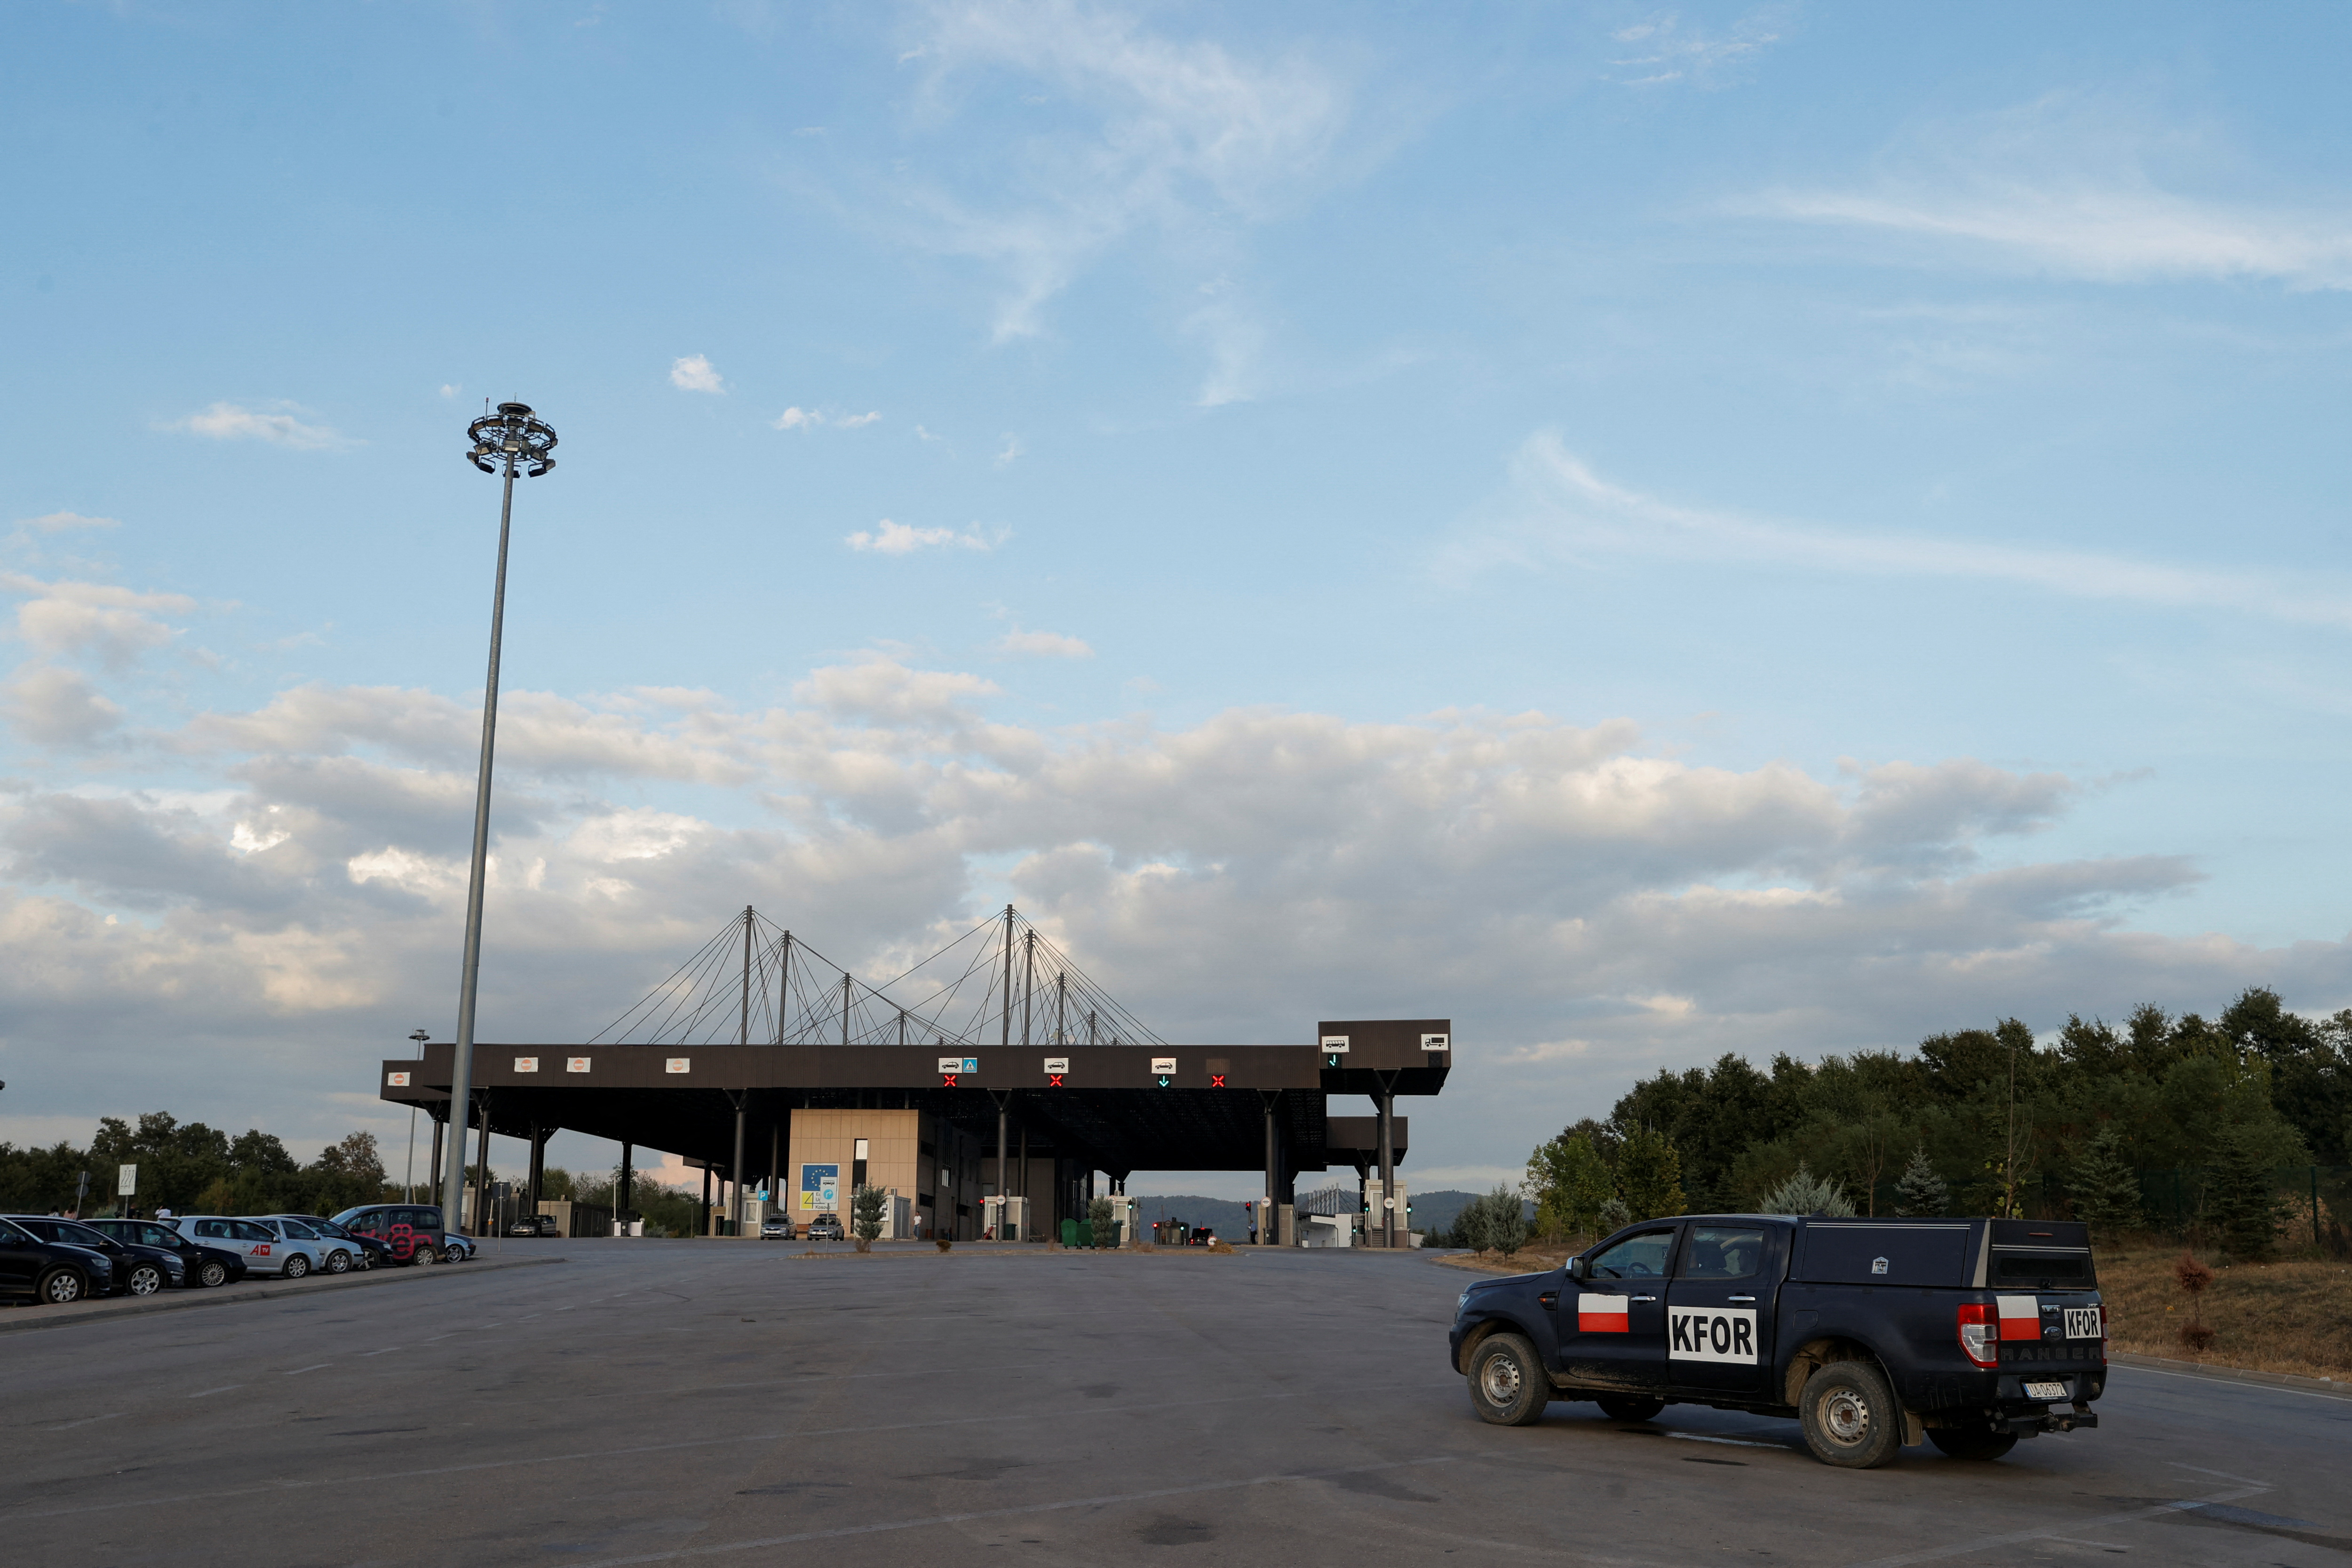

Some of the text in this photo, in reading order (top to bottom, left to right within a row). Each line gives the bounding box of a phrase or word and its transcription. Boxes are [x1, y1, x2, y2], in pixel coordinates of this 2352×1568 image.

[1672, 1315, 1753, 1355] KFOR
[2067, 1310, 2098, 1336] KFOR
[2001, 1348, 2100, 1360] RANGER
